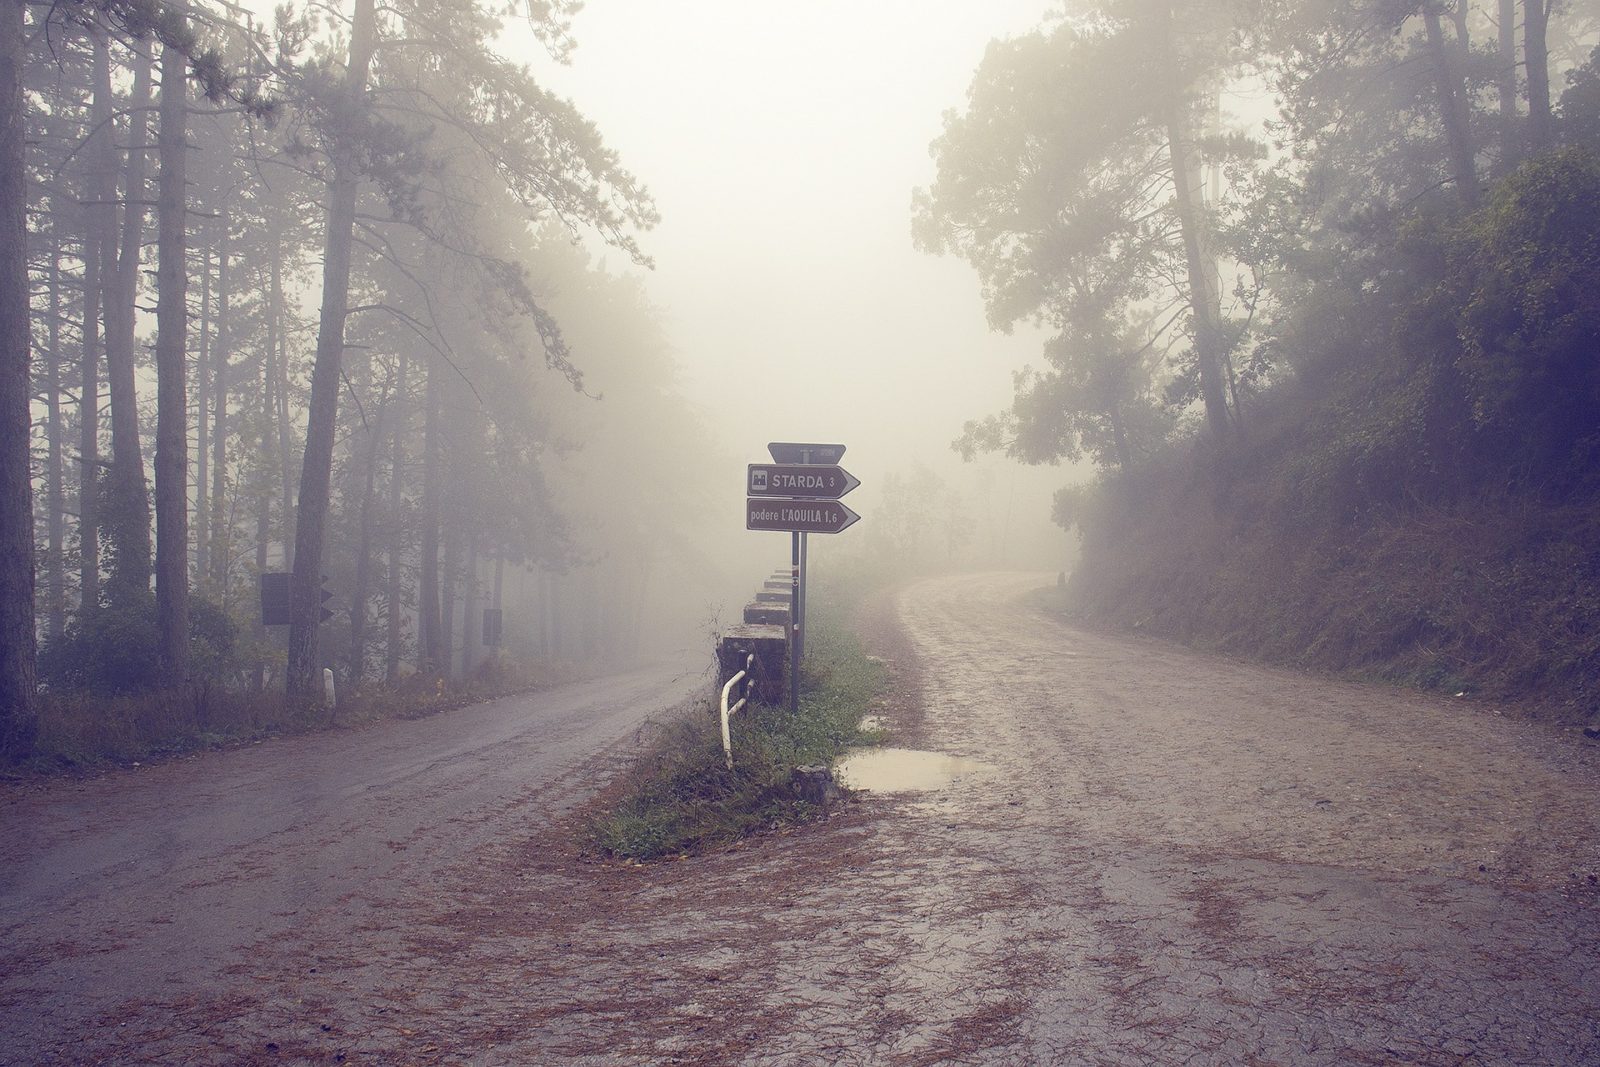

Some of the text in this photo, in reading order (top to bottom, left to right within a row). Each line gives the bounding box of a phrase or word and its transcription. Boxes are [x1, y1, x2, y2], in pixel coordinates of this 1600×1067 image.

[772, 475, 835, 488] STARDA 3
[751, 509, 779, 522] podere
